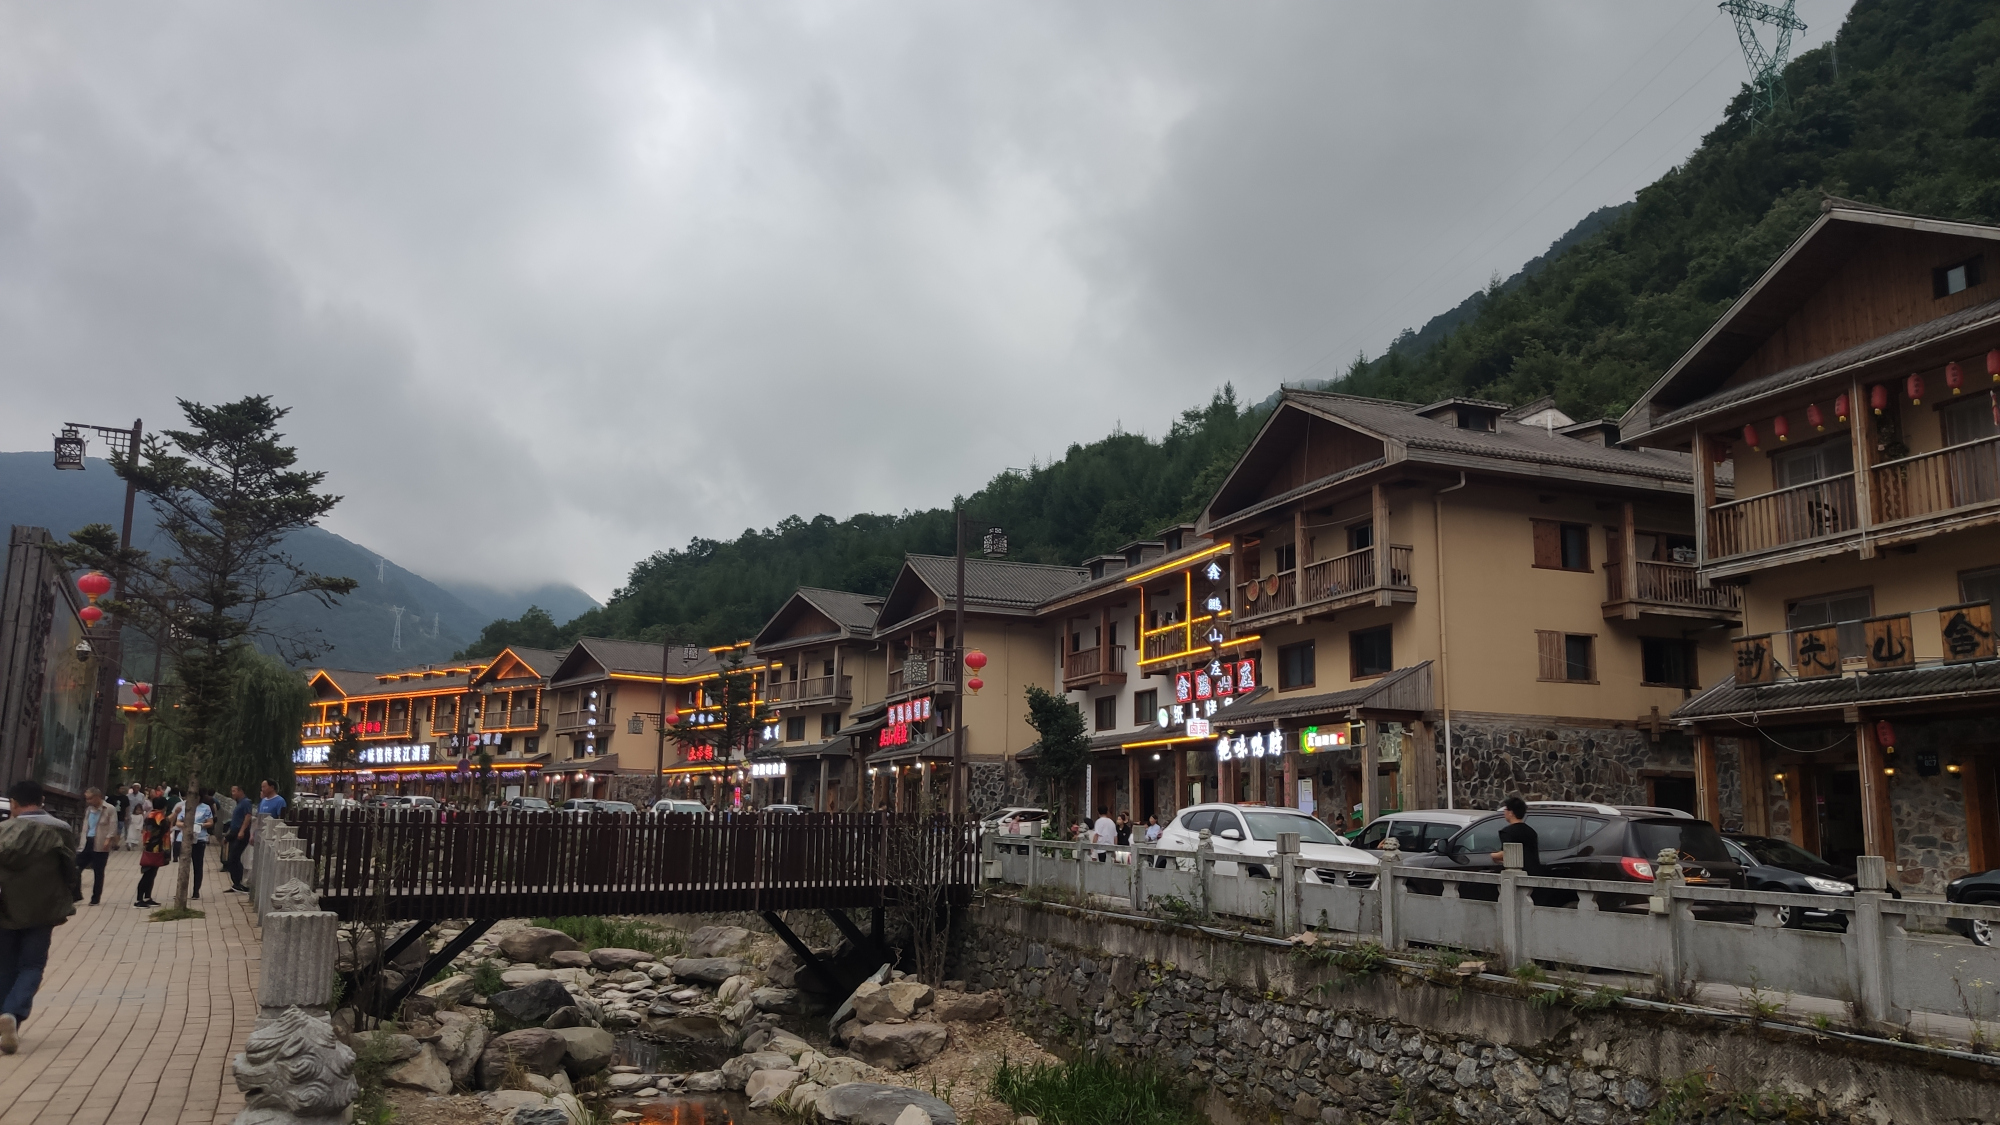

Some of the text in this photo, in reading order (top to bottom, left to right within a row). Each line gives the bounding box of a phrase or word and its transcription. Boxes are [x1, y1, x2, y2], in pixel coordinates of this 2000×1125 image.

[1207, 562, 1223, 676] 鑫鹏山庄
[1737, 612, 1990, 680] 湖光山舍
[1190, 721, 1208, 735] 卤菜
